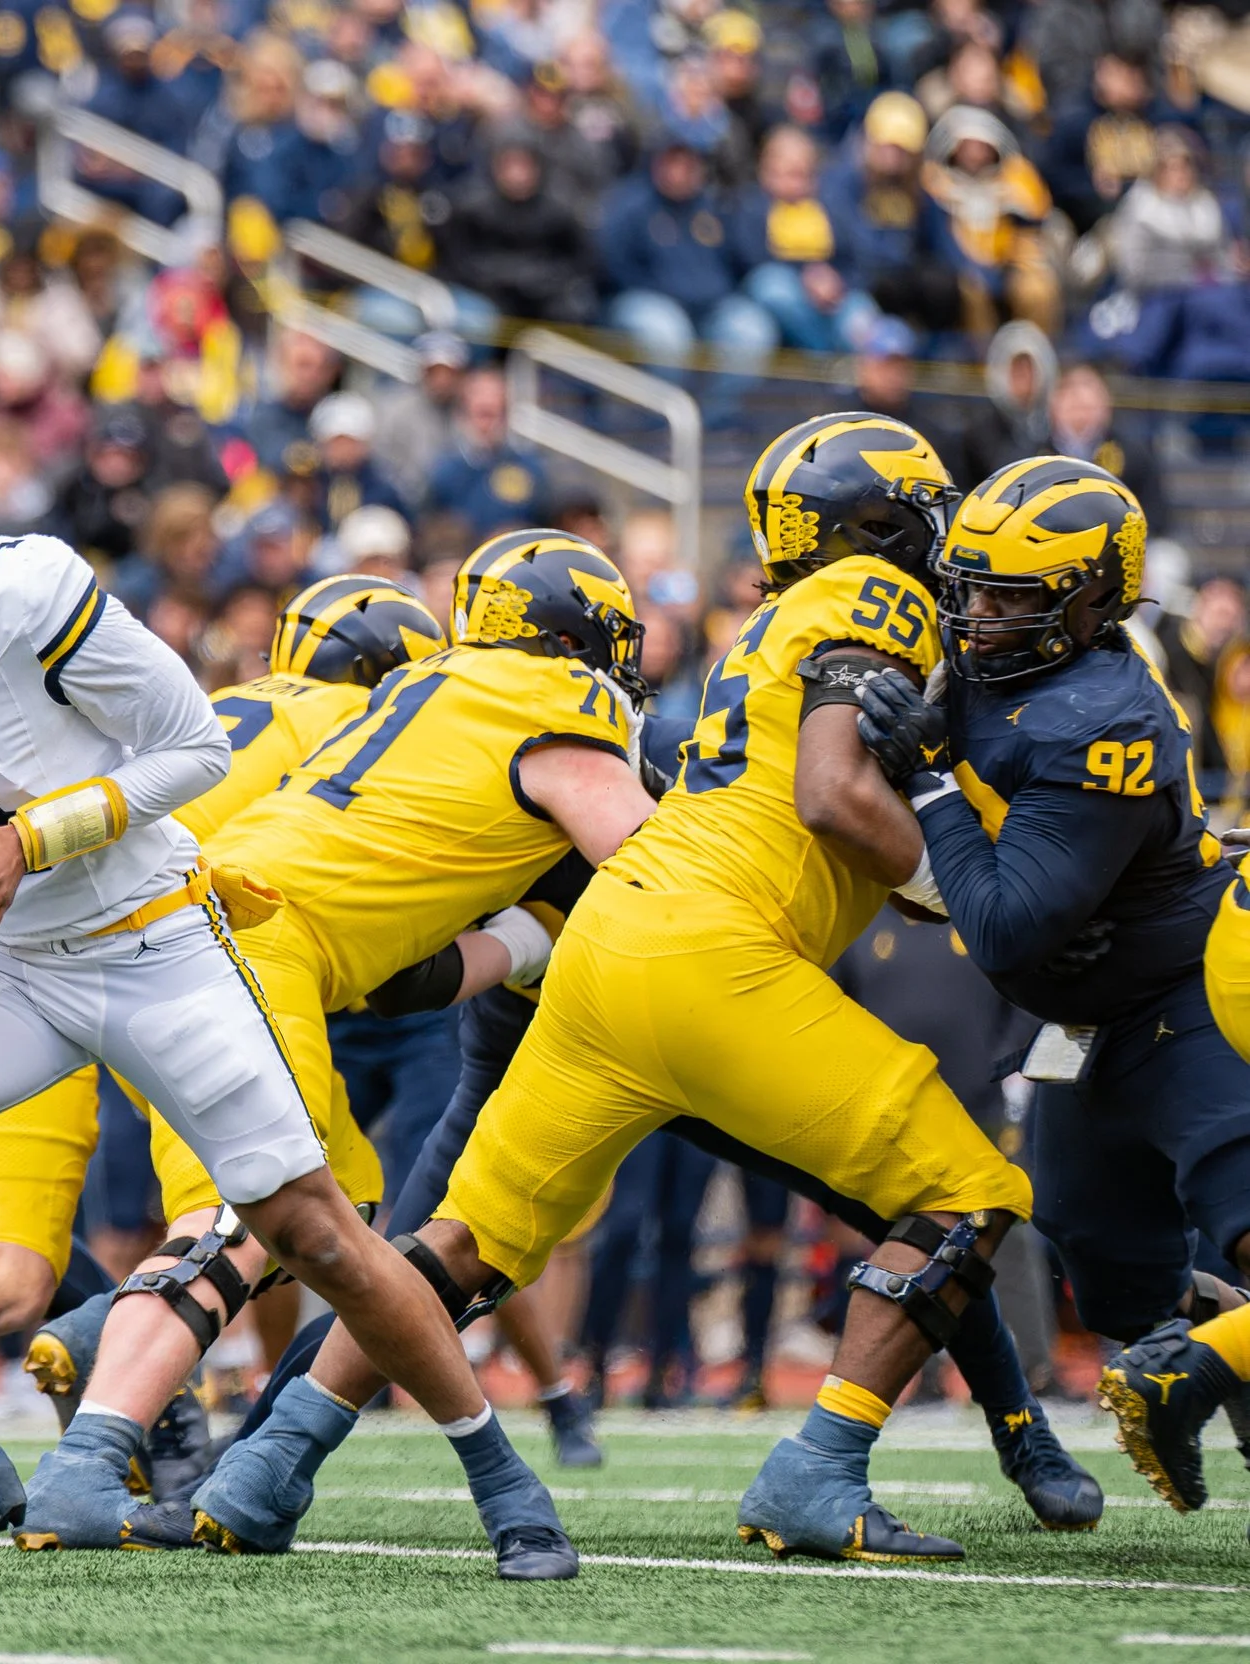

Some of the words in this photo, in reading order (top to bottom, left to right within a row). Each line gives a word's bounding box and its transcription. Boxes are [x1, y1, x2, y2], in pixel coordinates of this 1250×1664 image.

[851, 576, 928, 649] 55
[569, 669, 619, 729] 71
[1082, 740, 1155, 796] 92
